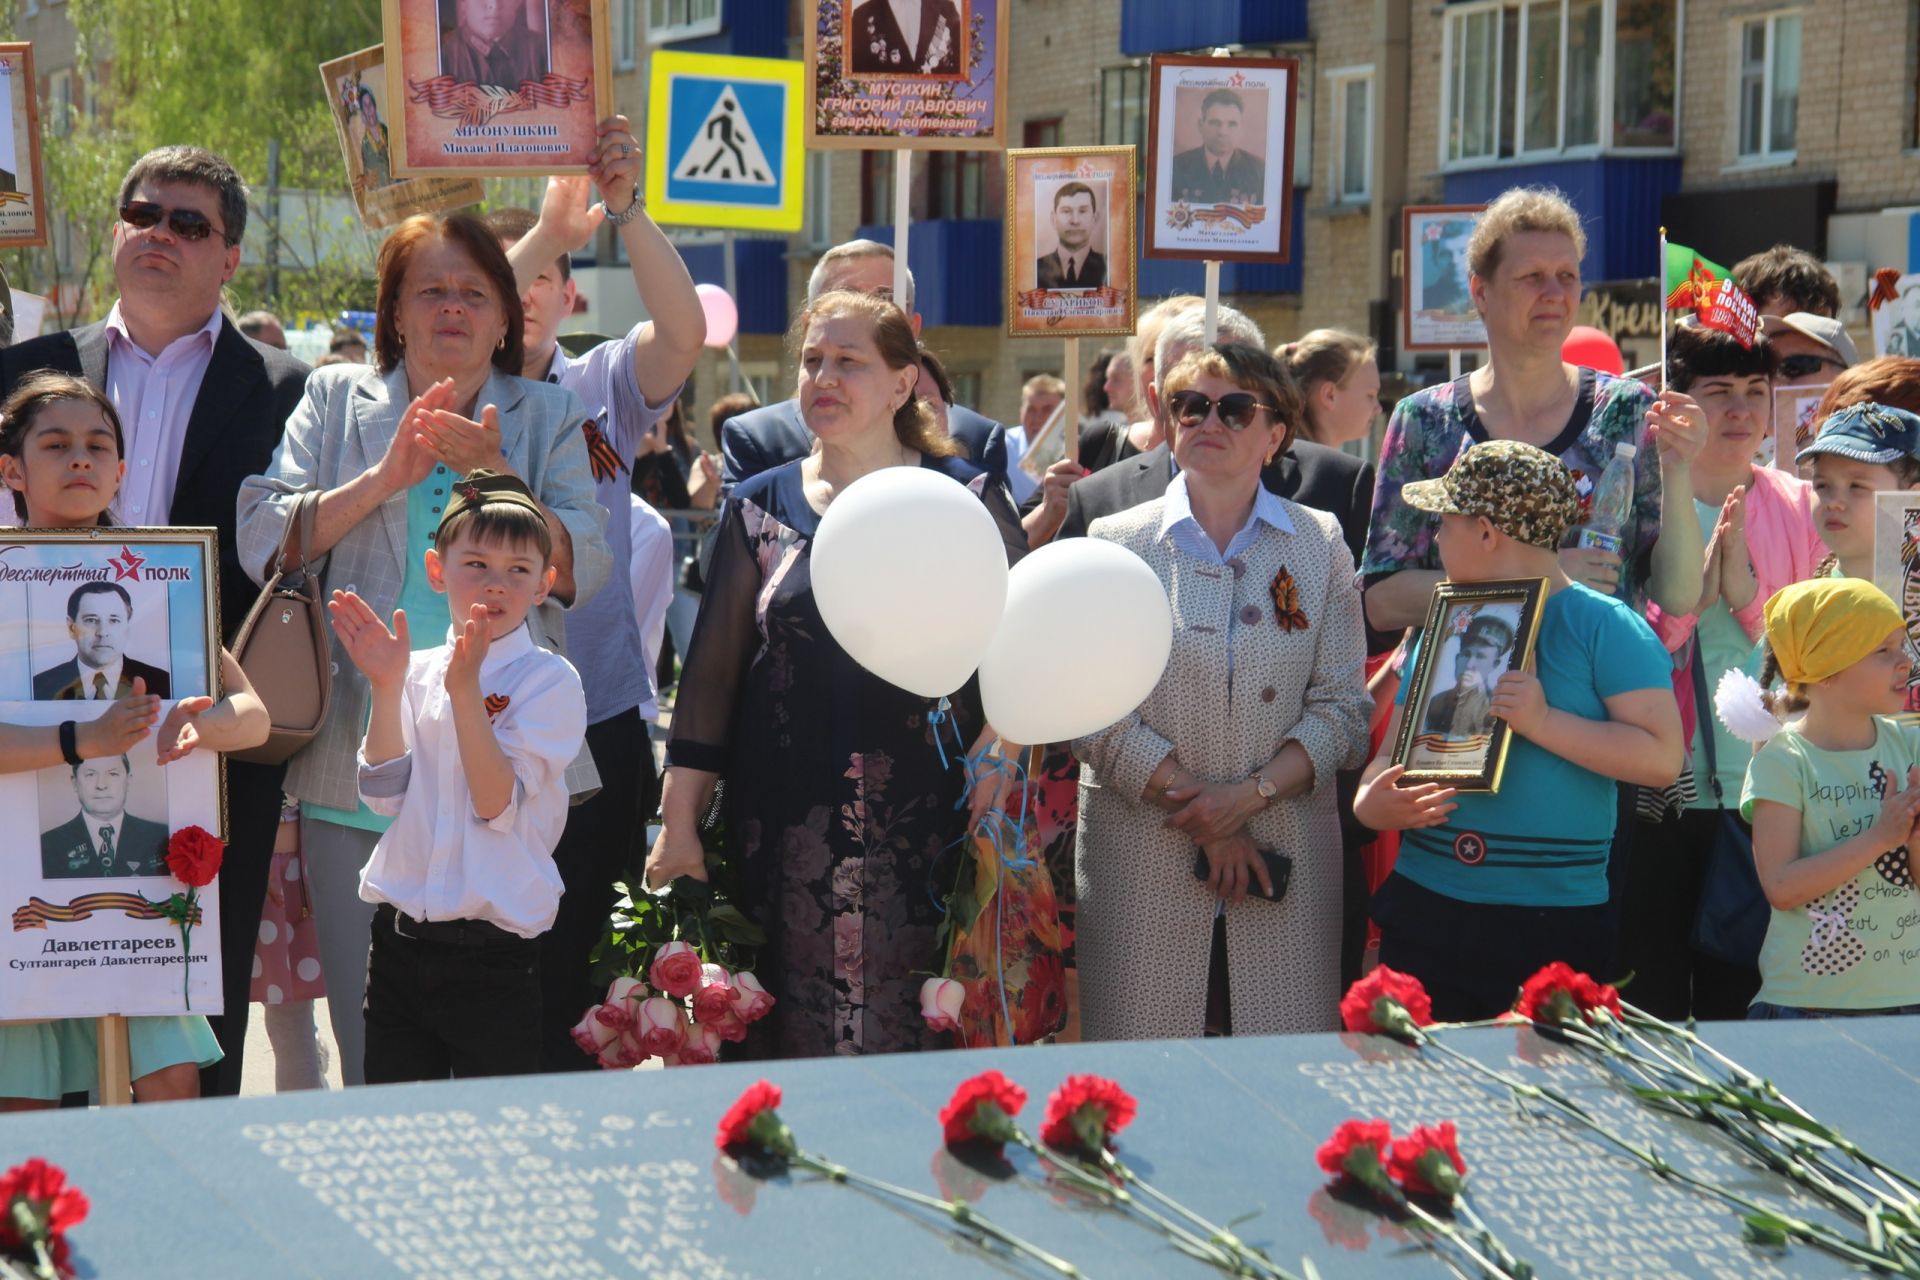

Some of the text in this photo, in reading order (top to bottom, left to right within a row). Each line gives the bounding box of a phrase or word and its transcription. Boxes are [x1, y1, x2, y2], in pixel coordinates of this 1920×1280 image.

[868, 83, 943, 96] МУСИХИН
[823, 98, 988, 113] ГРИГОРИЙ ПАВЛОВИЧ
[453, 125, 558, 137] АНТОНУШКИН
[443, 142, 570, 154] Михаил Платонович
[1721, 277, 1757, 322] 9 МАЯ!
[1716, 292, 1756, 333] ПОБЕДА!
[42, 937, 176, 956] Давлетгареев
[9, 957, 97, 971] Султангарей
